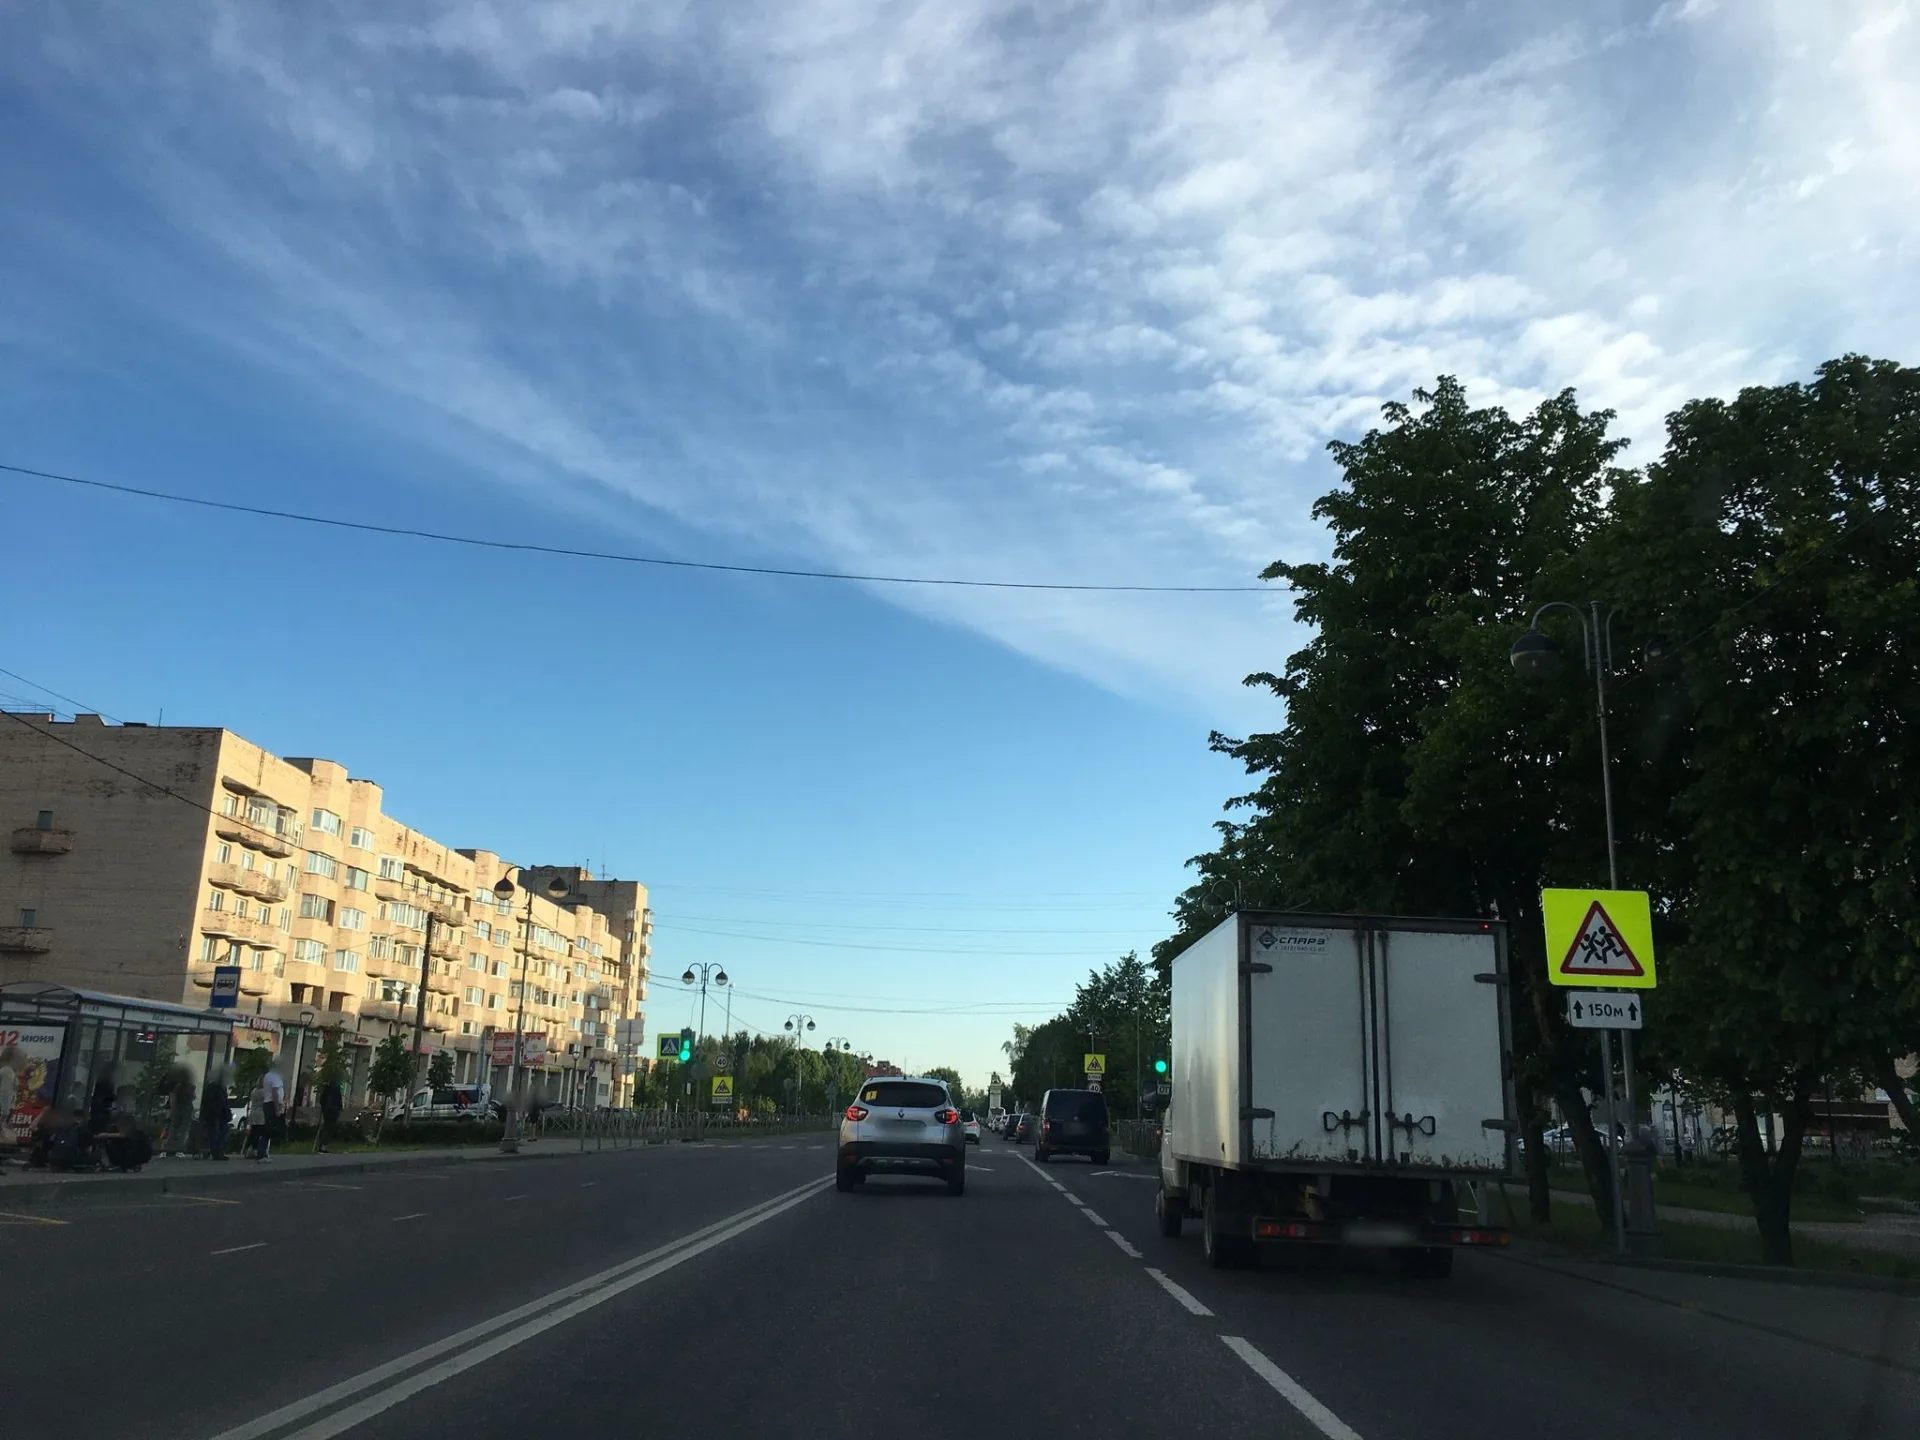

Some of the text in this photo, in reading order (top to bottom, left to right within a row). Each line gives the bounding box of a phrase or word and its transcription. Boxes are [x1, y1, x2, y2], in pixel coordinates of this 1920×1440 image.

[1588, 1003, 1624, 1017] 150м
[0, 1030, 20, 1047] 12
[717, 1057, 727, 1066] 40
